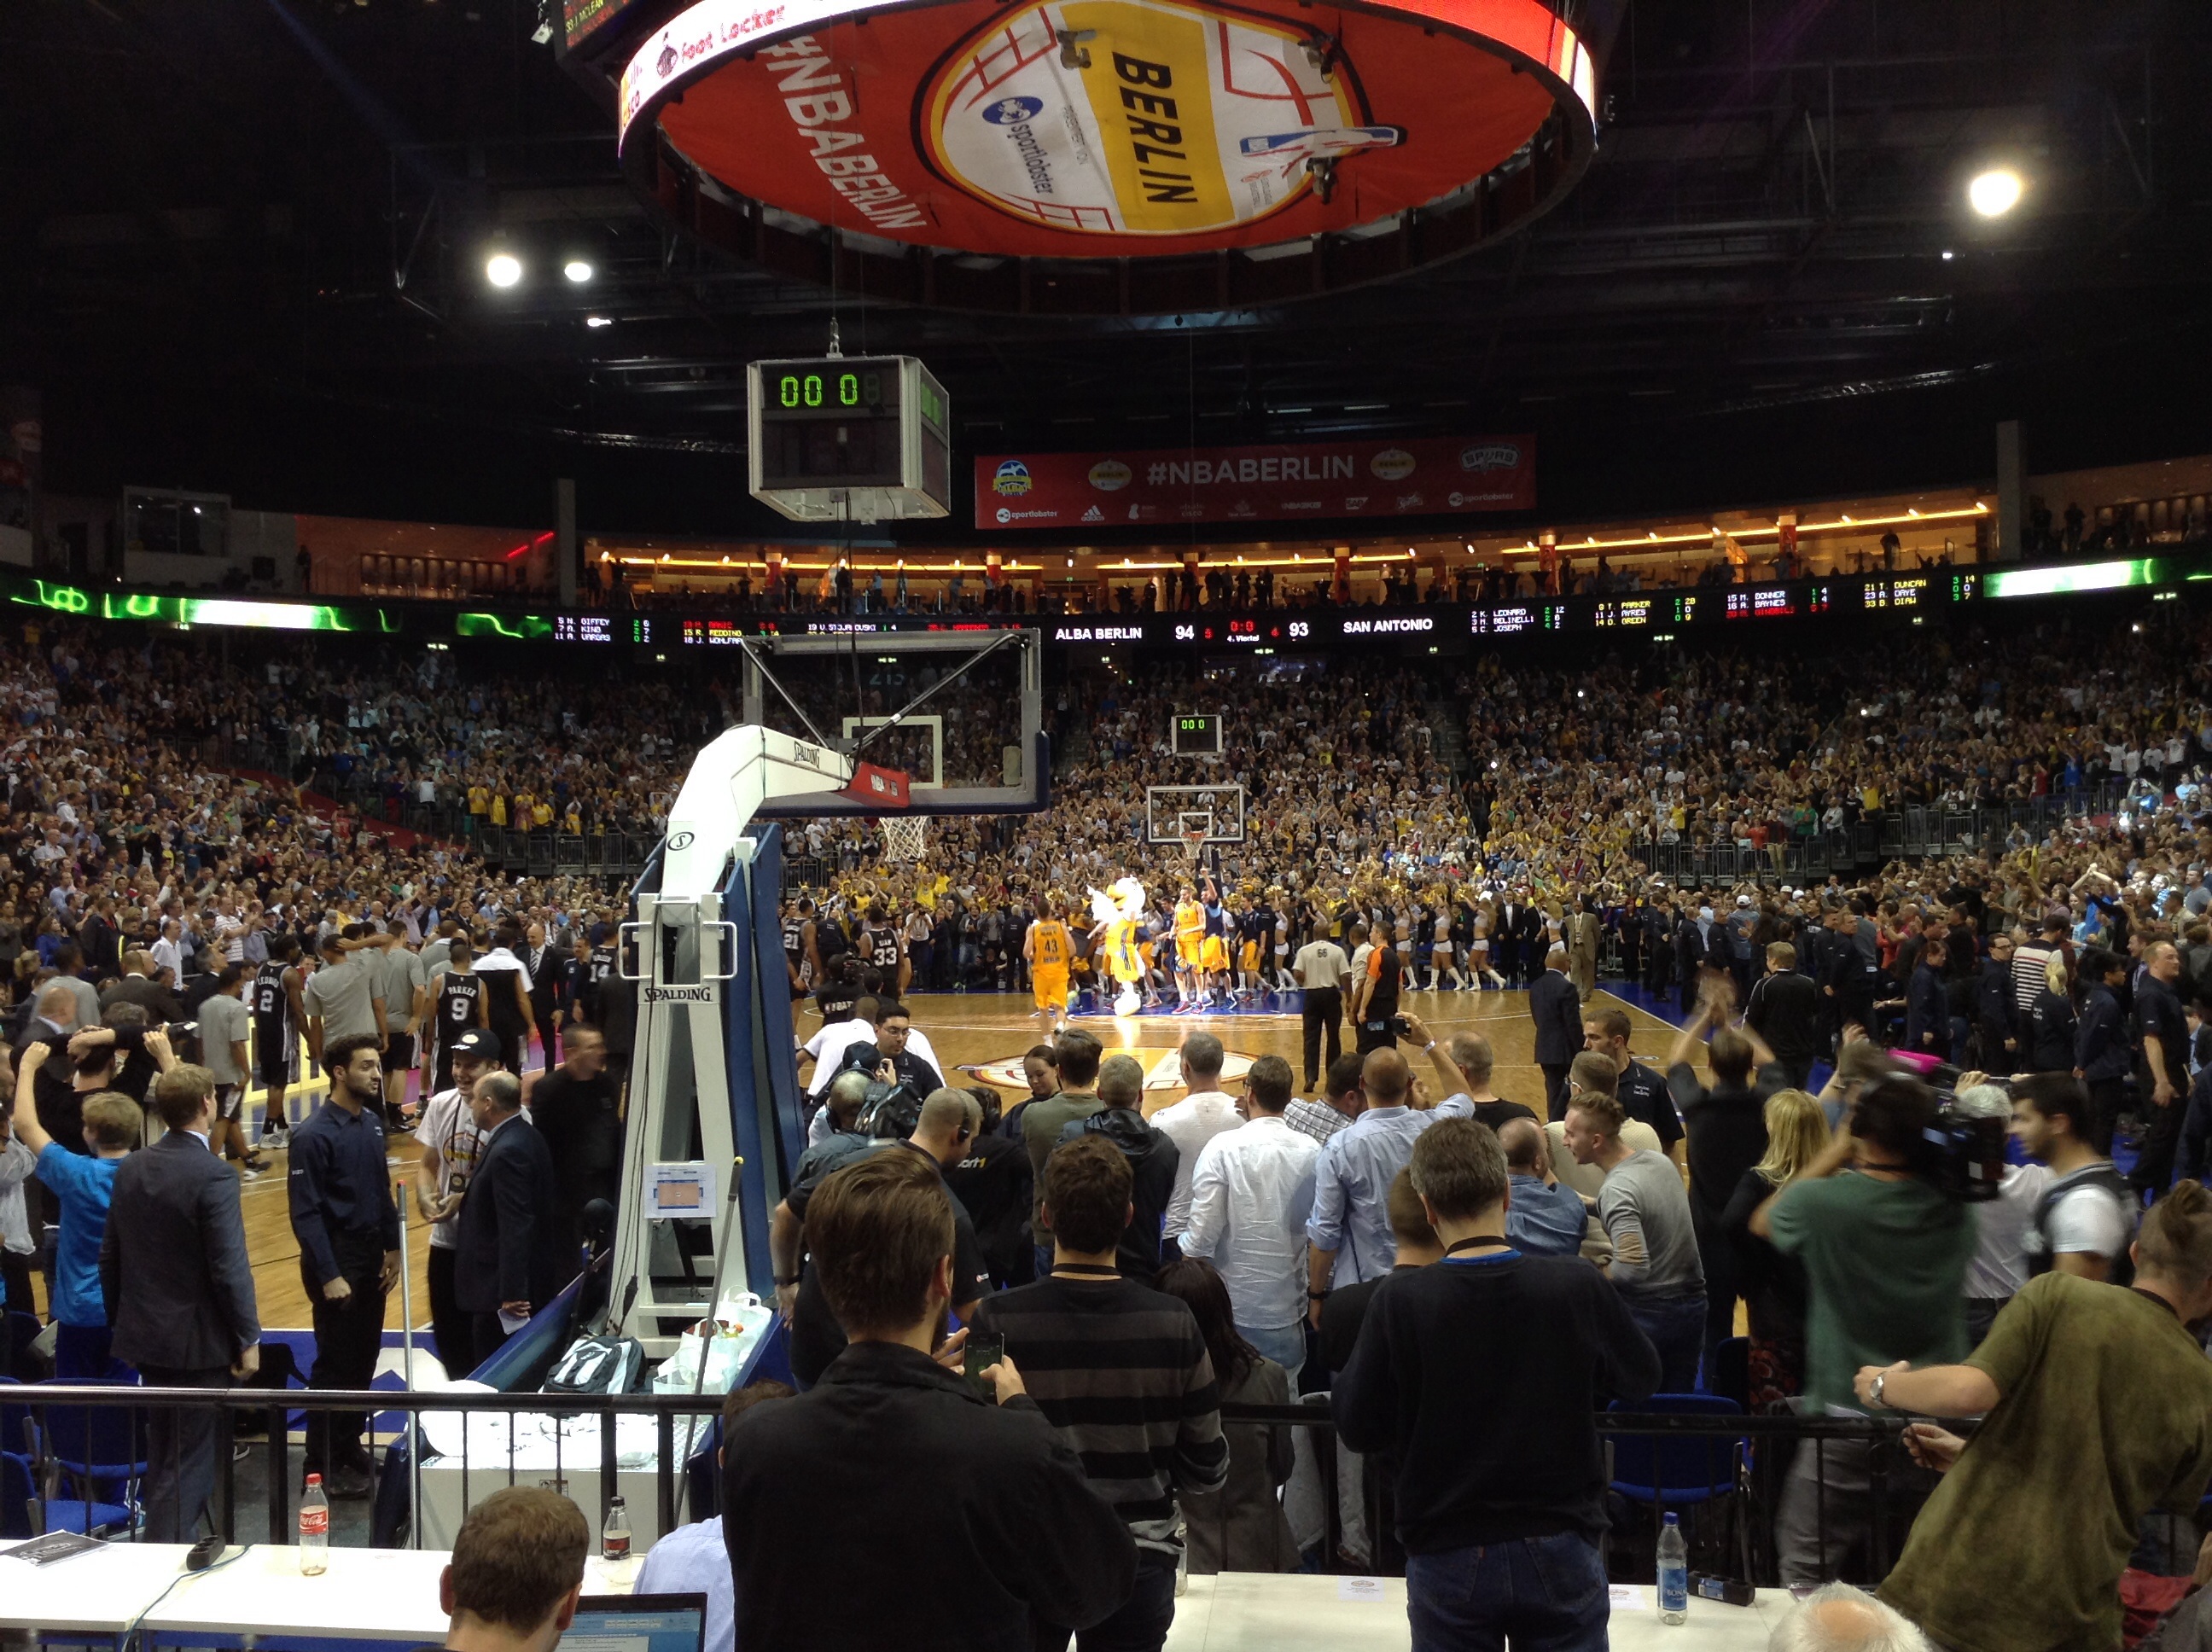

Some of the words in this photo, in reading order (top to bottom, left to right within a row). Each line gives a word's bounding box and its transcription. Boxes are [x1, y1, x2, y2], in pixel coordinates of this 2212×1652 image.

[757, 35, 928, 229] #NBABERLIN
[1112, 51, 1198, 203] BERLIN
[1007, 124, 1053, 194] sportlobster
[781, 375, 823, 407] 00
[840, 373, 858, 405] 0
[1147, 455, 1353, 485] #NBABERLIN
[1464, 492, 1514, 503] sportlobster
[1011, 510, 1057, 520] sportlobster
[1895, 579, 1926, 589] DUNCAN
[1965, 574, 1975, 583] 14
[1175, 625, 1195, 640] 94
[1289, 622, 1309, 637] 93
[1343, 620, 1371, 633] SAN
[1373, 618, 1433, 631] ANTONIO
[1055, 628, 1092, 640] ALBA
[1095, 627, 1142, 639] BERLIN
[1236, 634, 1260, 643] Viertel
[1181, 719, 1195, 730] 00
[1198, 719, 1205, 730] 0
[794, 741, 819, 769] SPALDING
[783, 933, 799, 950] 21
[1045, 939, 1057, 952] 43
[873, 947, 897, 966] 33
[589, 964, 609, 982] 14
[447, 986, 477, 998] PARKER
[644, 987, 712, 1002] SPALDING
[259, 989, 274, 1013] 2
[451, 998, 470, 1021] 9
